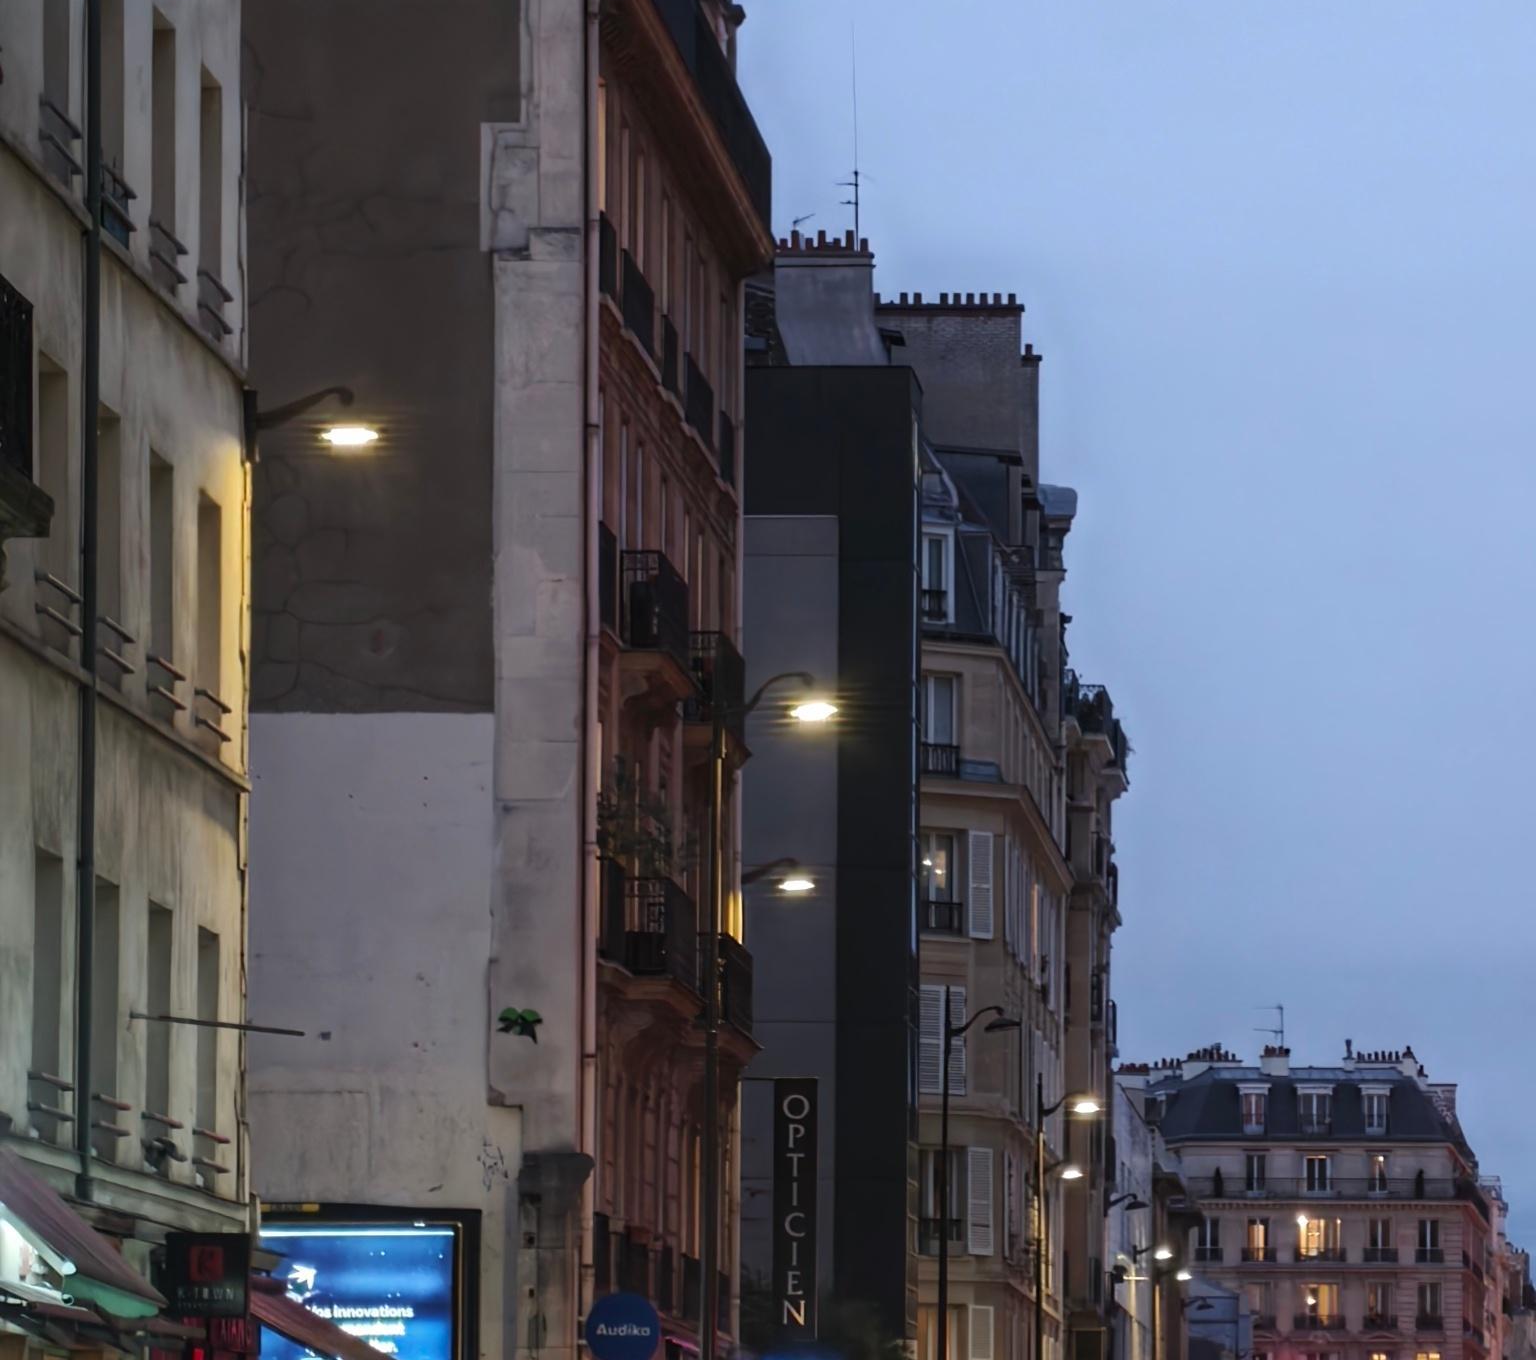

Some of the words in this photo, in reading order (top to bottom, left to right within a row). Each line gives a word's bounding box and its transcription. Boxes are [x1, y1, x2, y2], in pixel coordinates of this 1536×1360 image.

[783, 1094, 811, 1327] OPTICIEN
[333, 1304, 415, 1318] innovations
[596, 1323, 651, 1336] Audika
